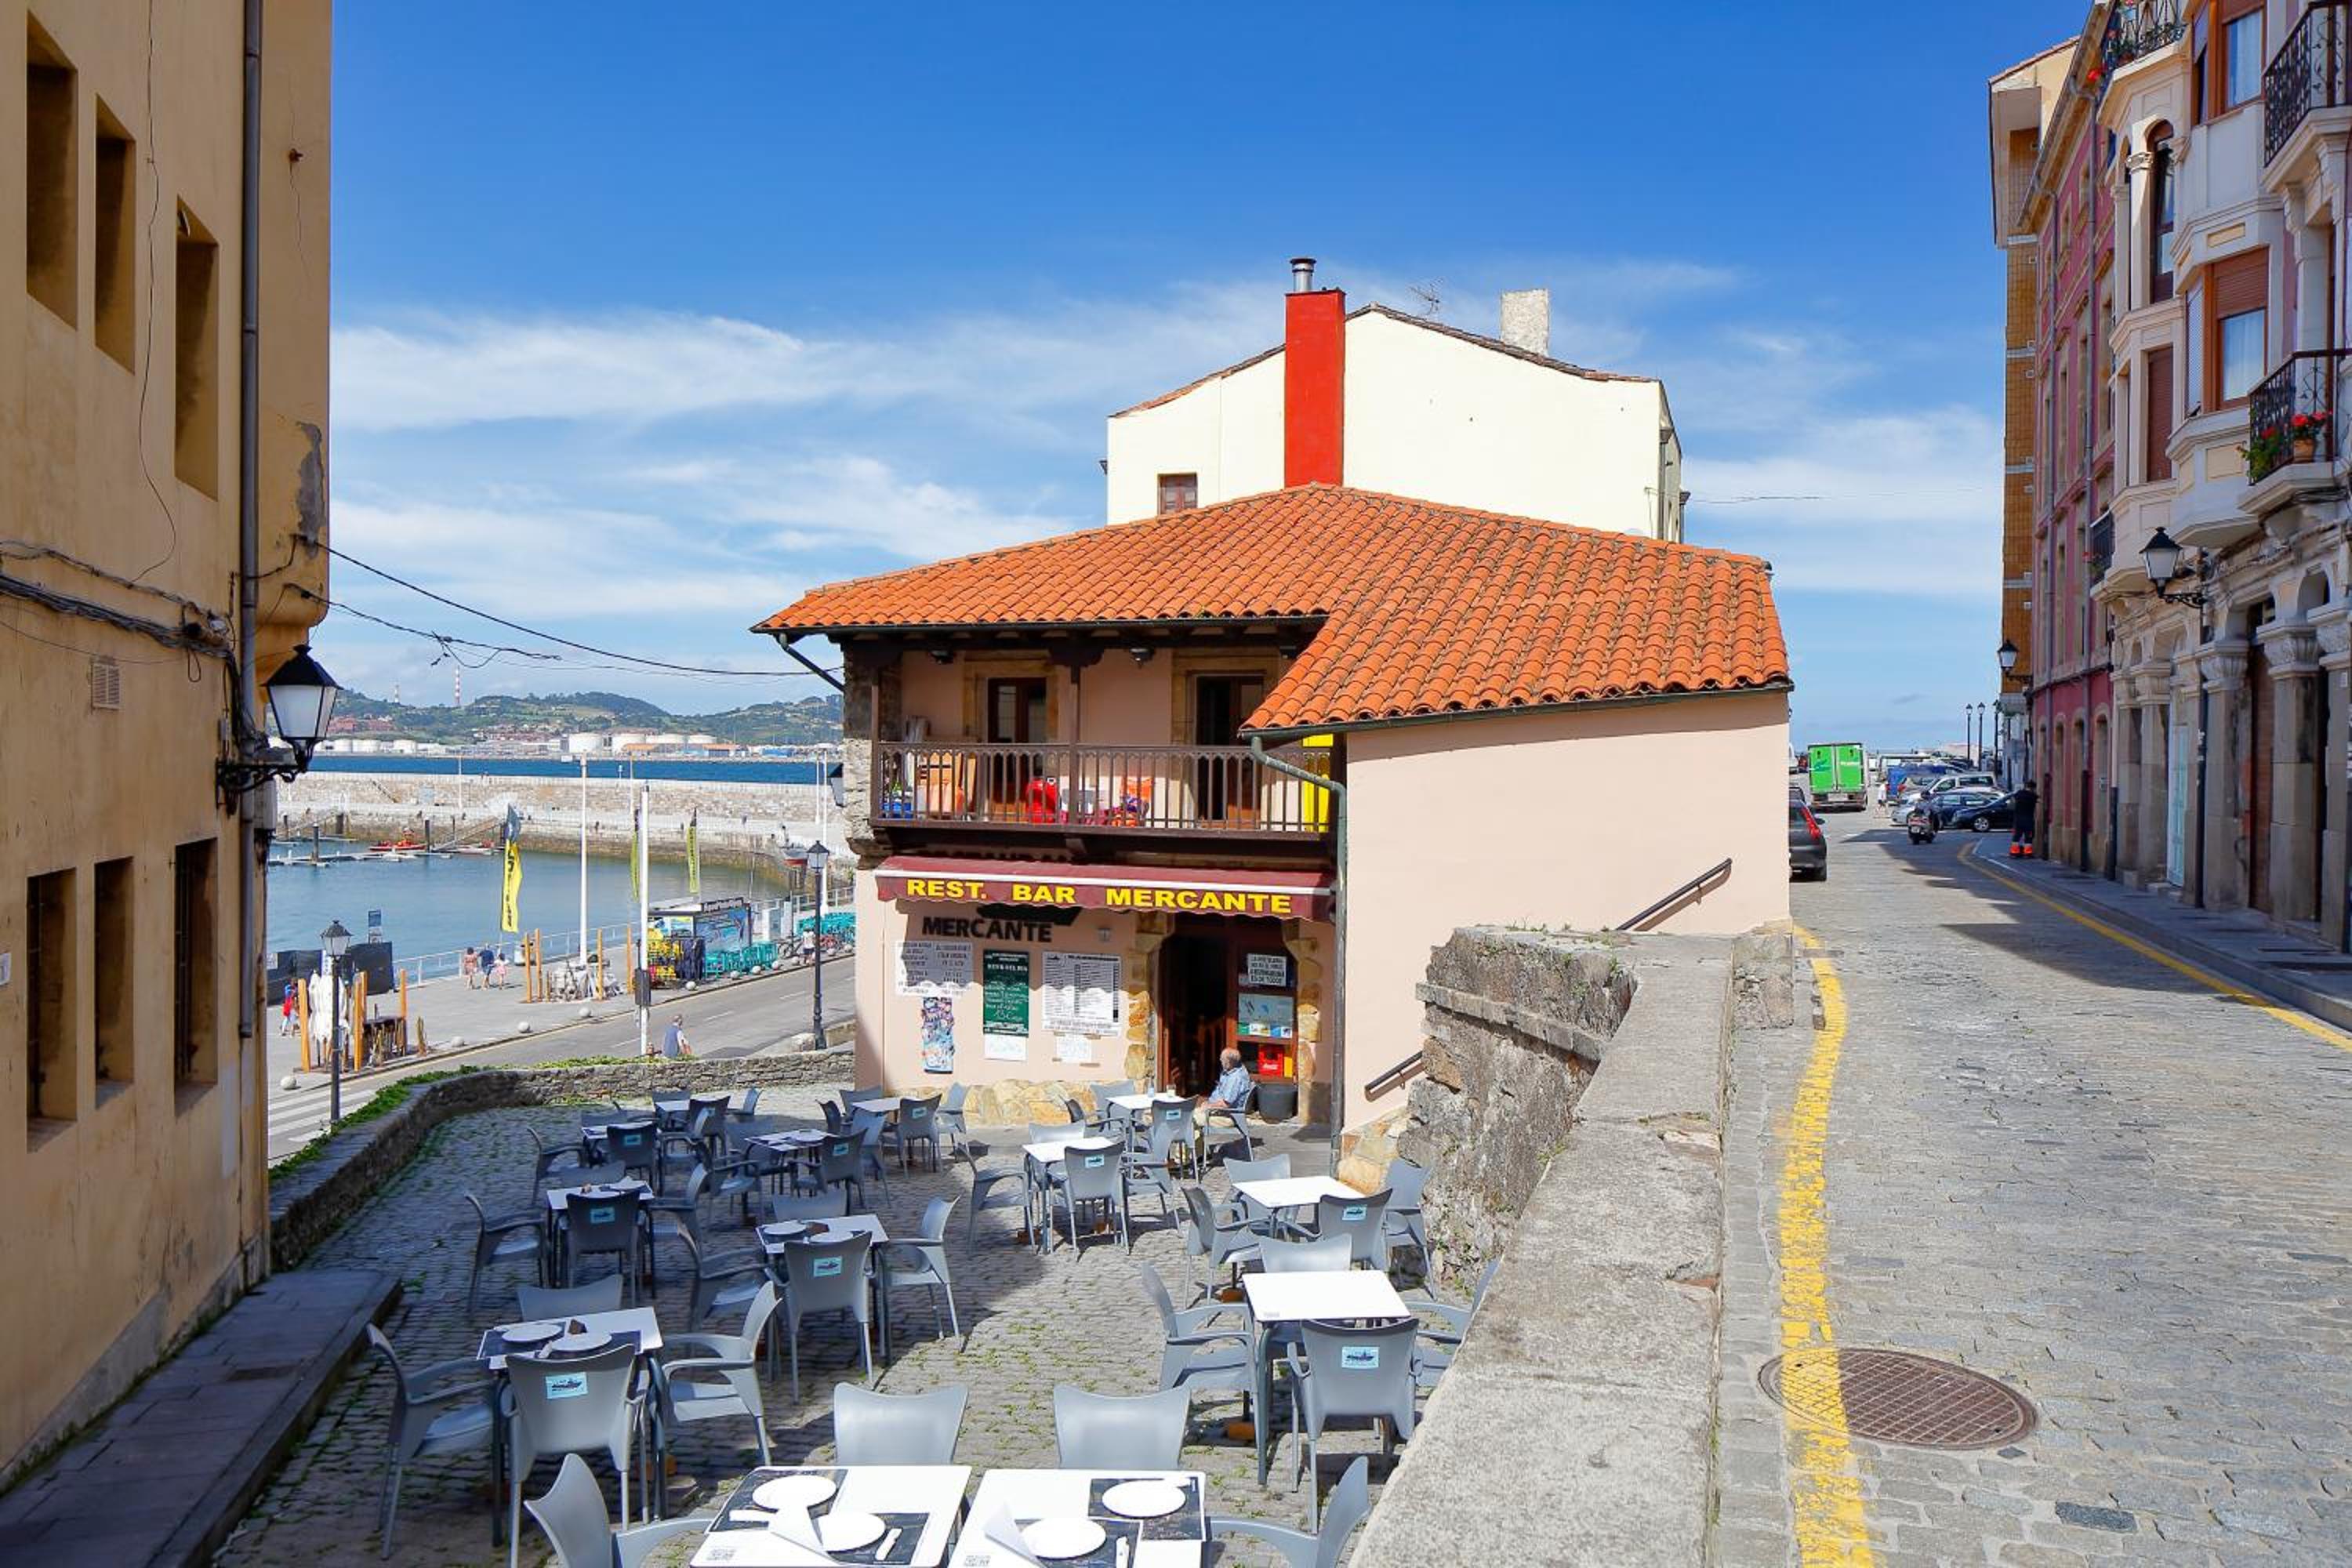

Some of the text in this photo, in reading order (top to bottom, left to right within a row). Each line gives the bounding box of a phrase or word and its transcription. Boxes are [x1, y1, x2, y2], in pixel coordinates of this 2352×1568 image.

[907, 879, 1292, 913] REST. BAR MERCANTE
[922, 916, 1052, 942] MERCANTE
